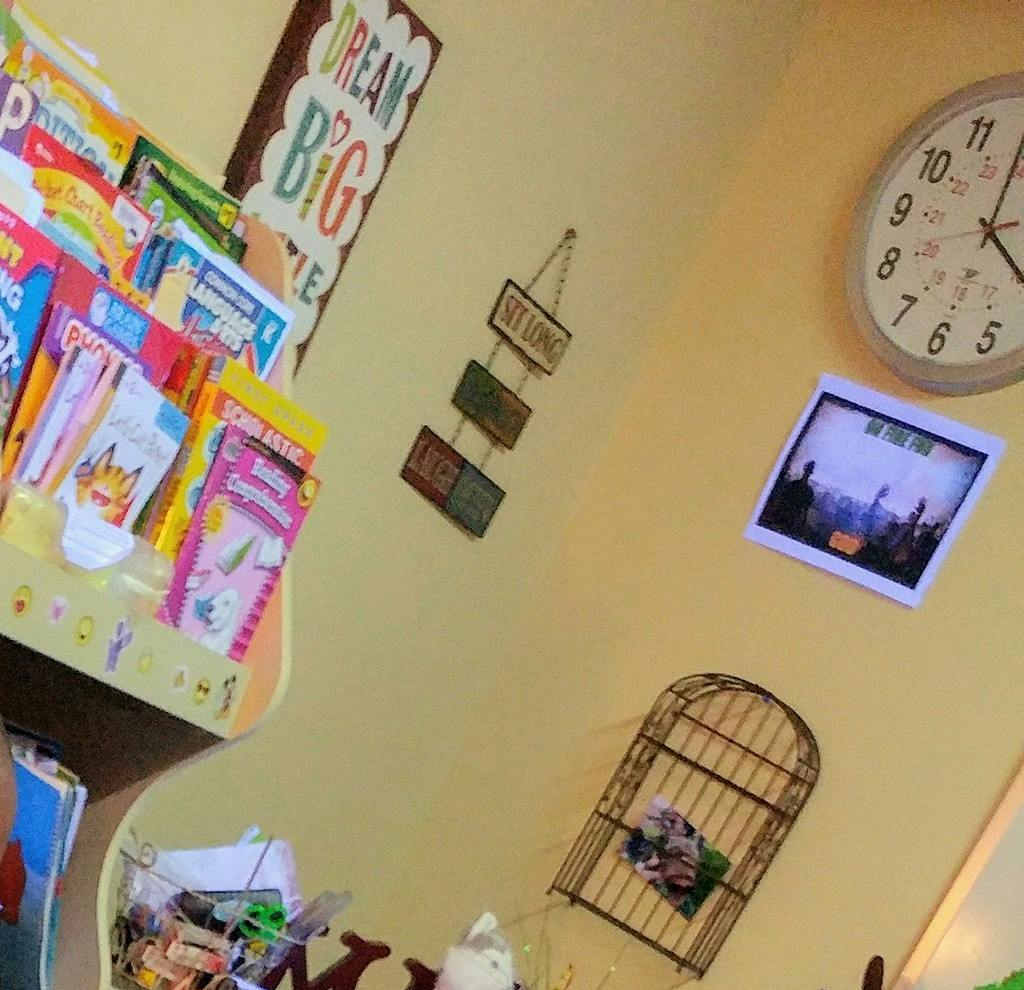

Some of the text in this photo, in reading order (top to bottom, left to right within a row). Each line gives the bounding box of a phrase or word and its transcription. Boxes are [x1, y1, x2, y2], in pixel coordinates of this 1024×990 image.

[318, 1, 415, 131] DREAM
[966, 115, 996, 152] 11
[272, 94, 368, 241] BIG
[918, 146, 952, 184] 10
[889, 192, 913, 227] 9
[876, 246, 902, 281] 8
[891, 293, 919, 327] 7
[927, 321, 952, 356] 6
[976, 320, 1003, 355] 5
